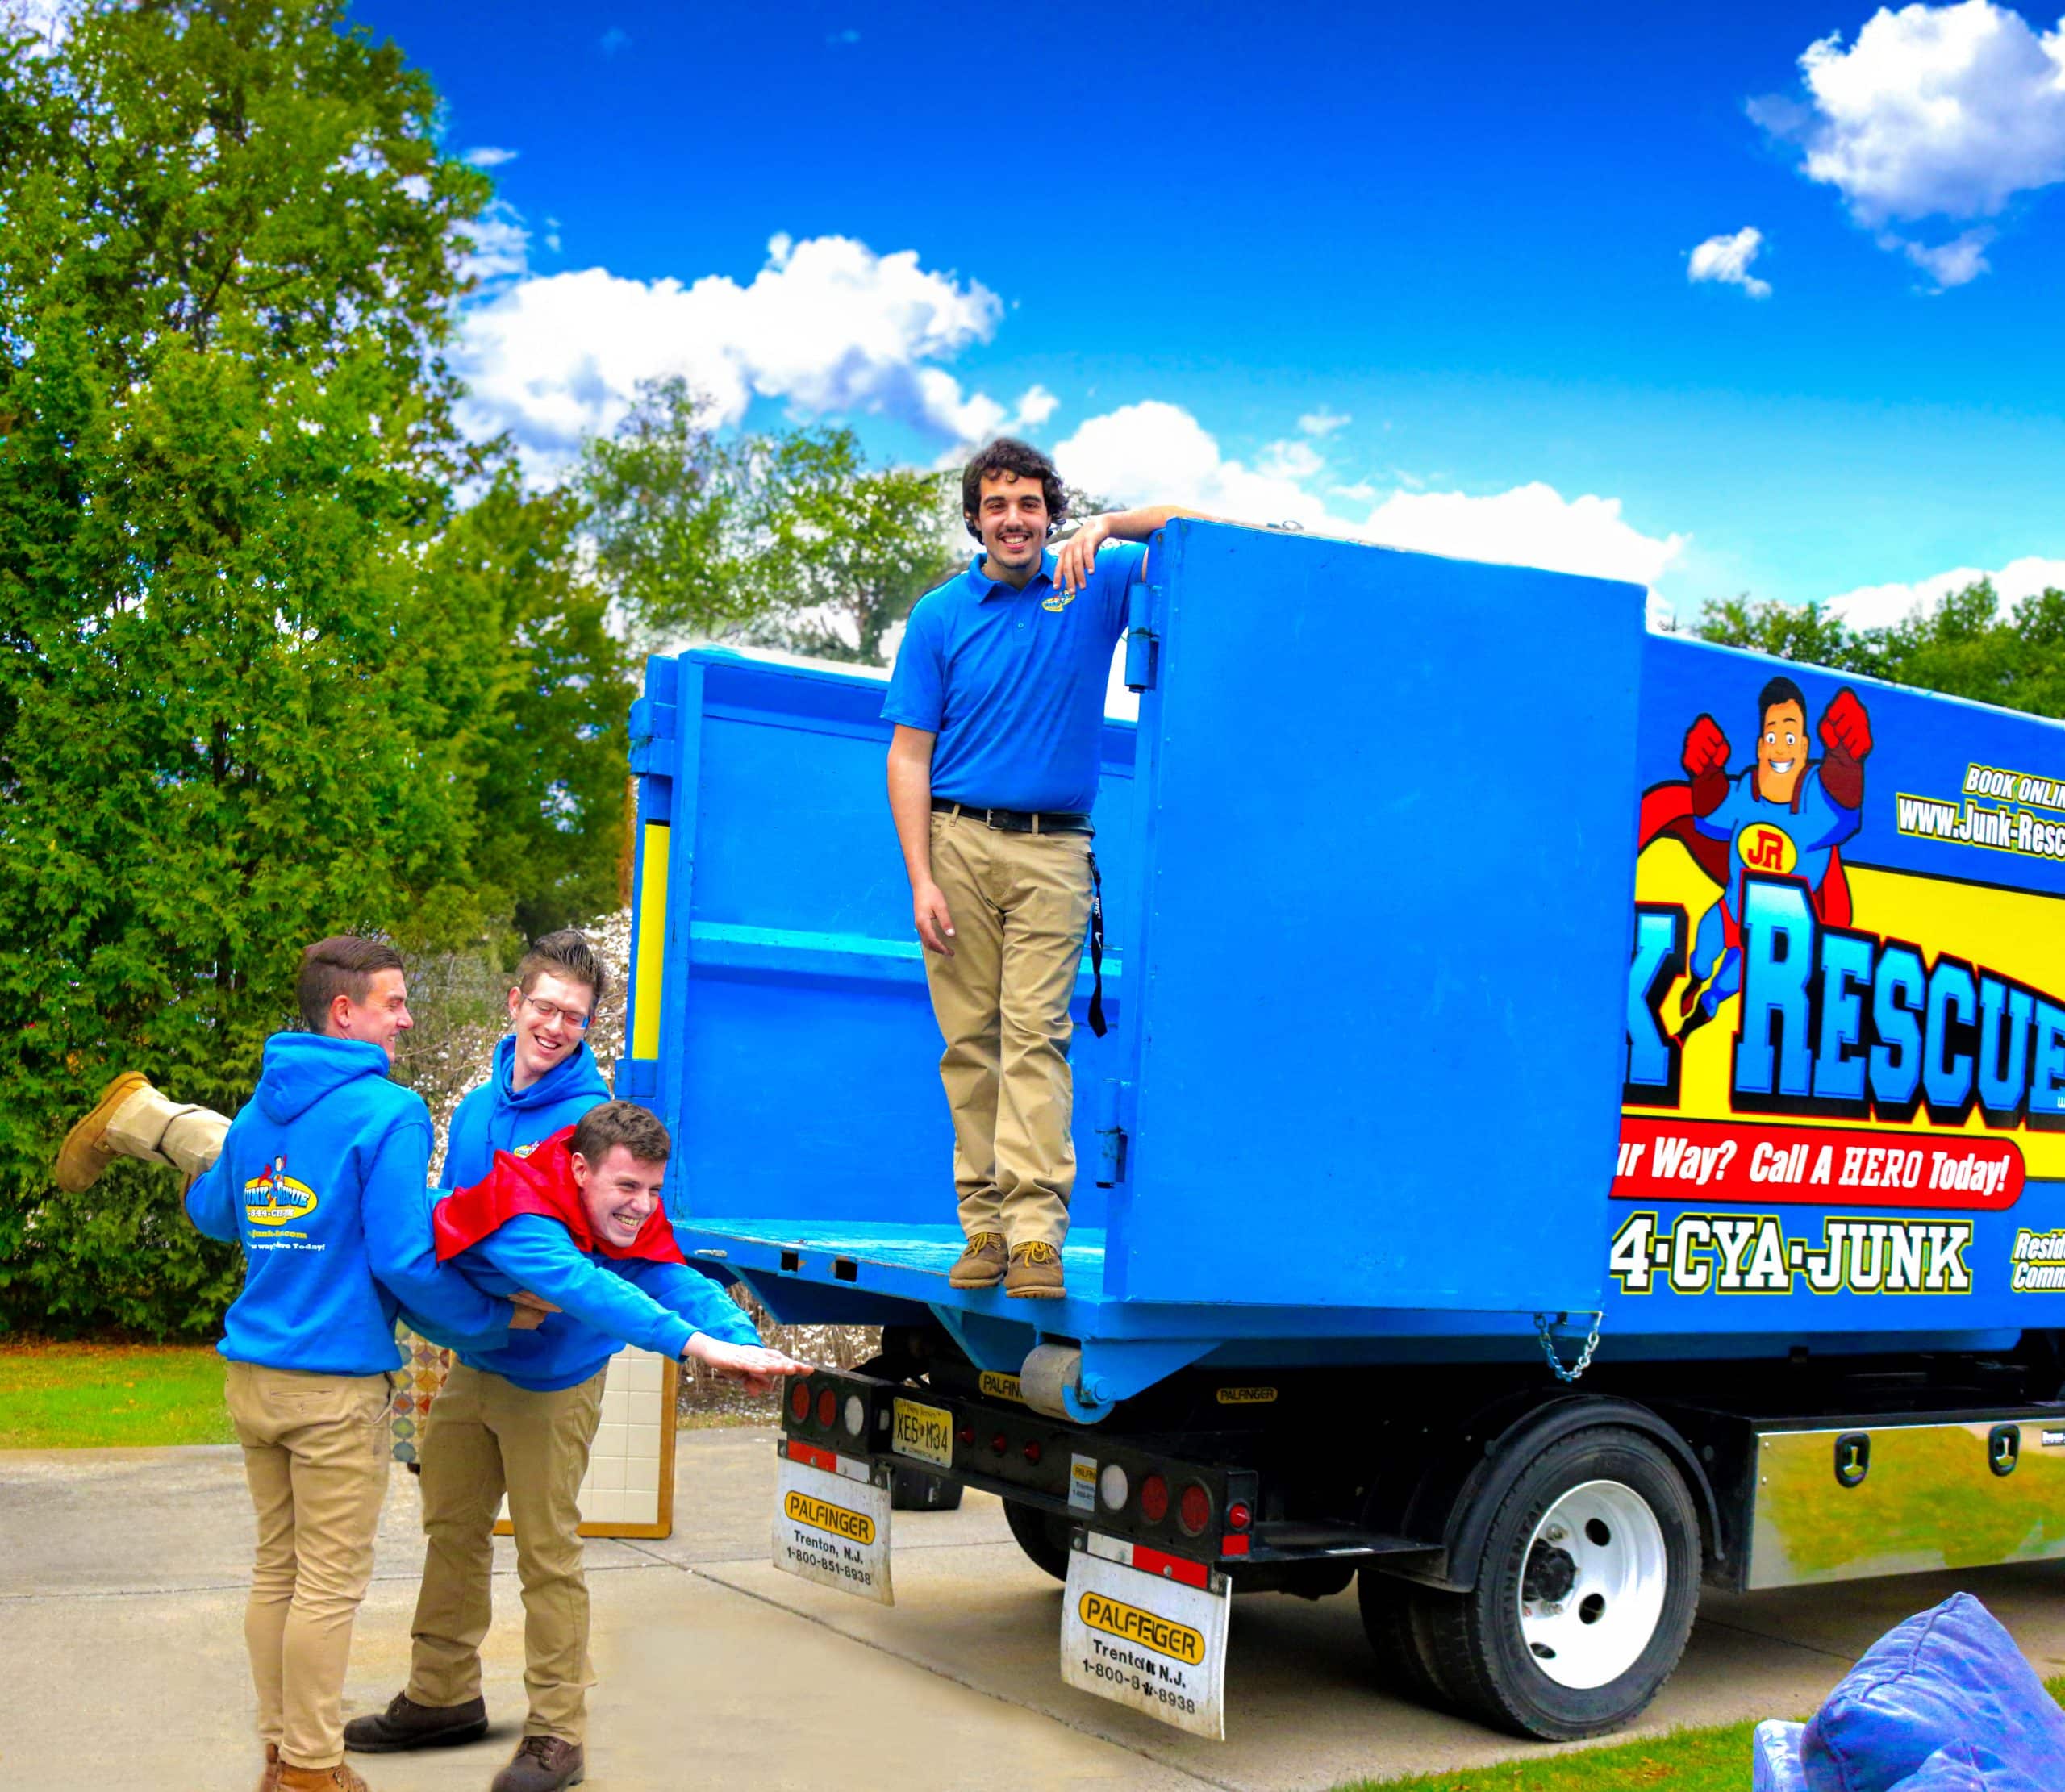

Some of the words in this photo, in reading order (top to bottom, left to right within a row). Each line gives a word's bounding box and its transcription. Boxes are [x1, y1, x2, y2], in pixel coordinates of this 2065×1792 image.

[1965, 766, 2017, 799] BOOK
[1747, 829, 1783, 871] JR
[1735, 881, 2065, 1114] RESCUE
[1651, 1136, 1738, 1186] Way?
[1749, 1141, 1810, 1184] Call
[1809, 1144, 1833, 1186] A
[1838, 1146, 1924, 1189] HERO
[1929, 1151, 2011, 1197] Today!
[983, 1374, 1023, 1399] PALFIN
[791, 1496, 869, 1540] PALFINGER
[786, 1546, 871, 1586] 1-800-851-8938
[794, 1529, 839, 1558] Trenton,
[844, 1546, 863, 1565] N.J.
[1159, 1665, 1186, 1689] N.J.
